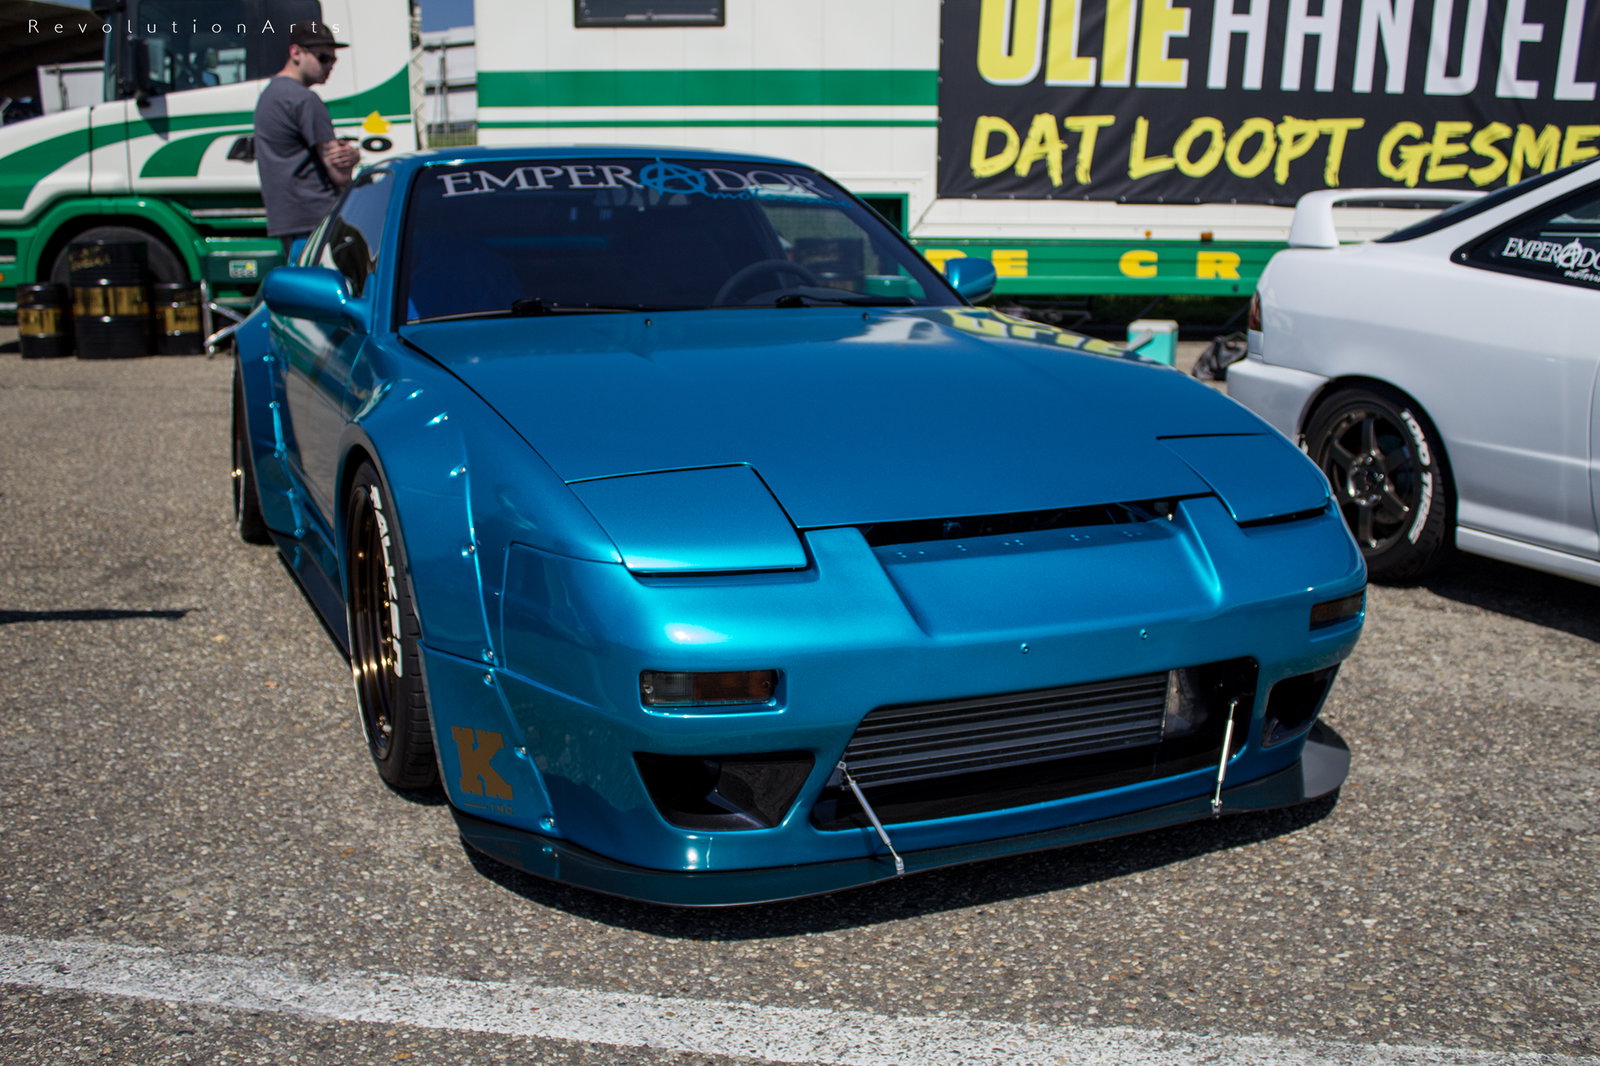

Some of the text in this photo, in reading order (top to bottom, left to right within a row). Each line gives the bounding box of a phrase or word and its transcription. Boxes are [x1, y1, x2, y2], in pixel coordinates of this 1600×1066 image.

[437, 157, 834, 198] EMPERADOR
[970, 112, 1116, 188] DAT
[1128, 115, 1366, 187] LOOPT
[370, 484, 403, 678] FALKEN
[451, 725, 515, 801] K
